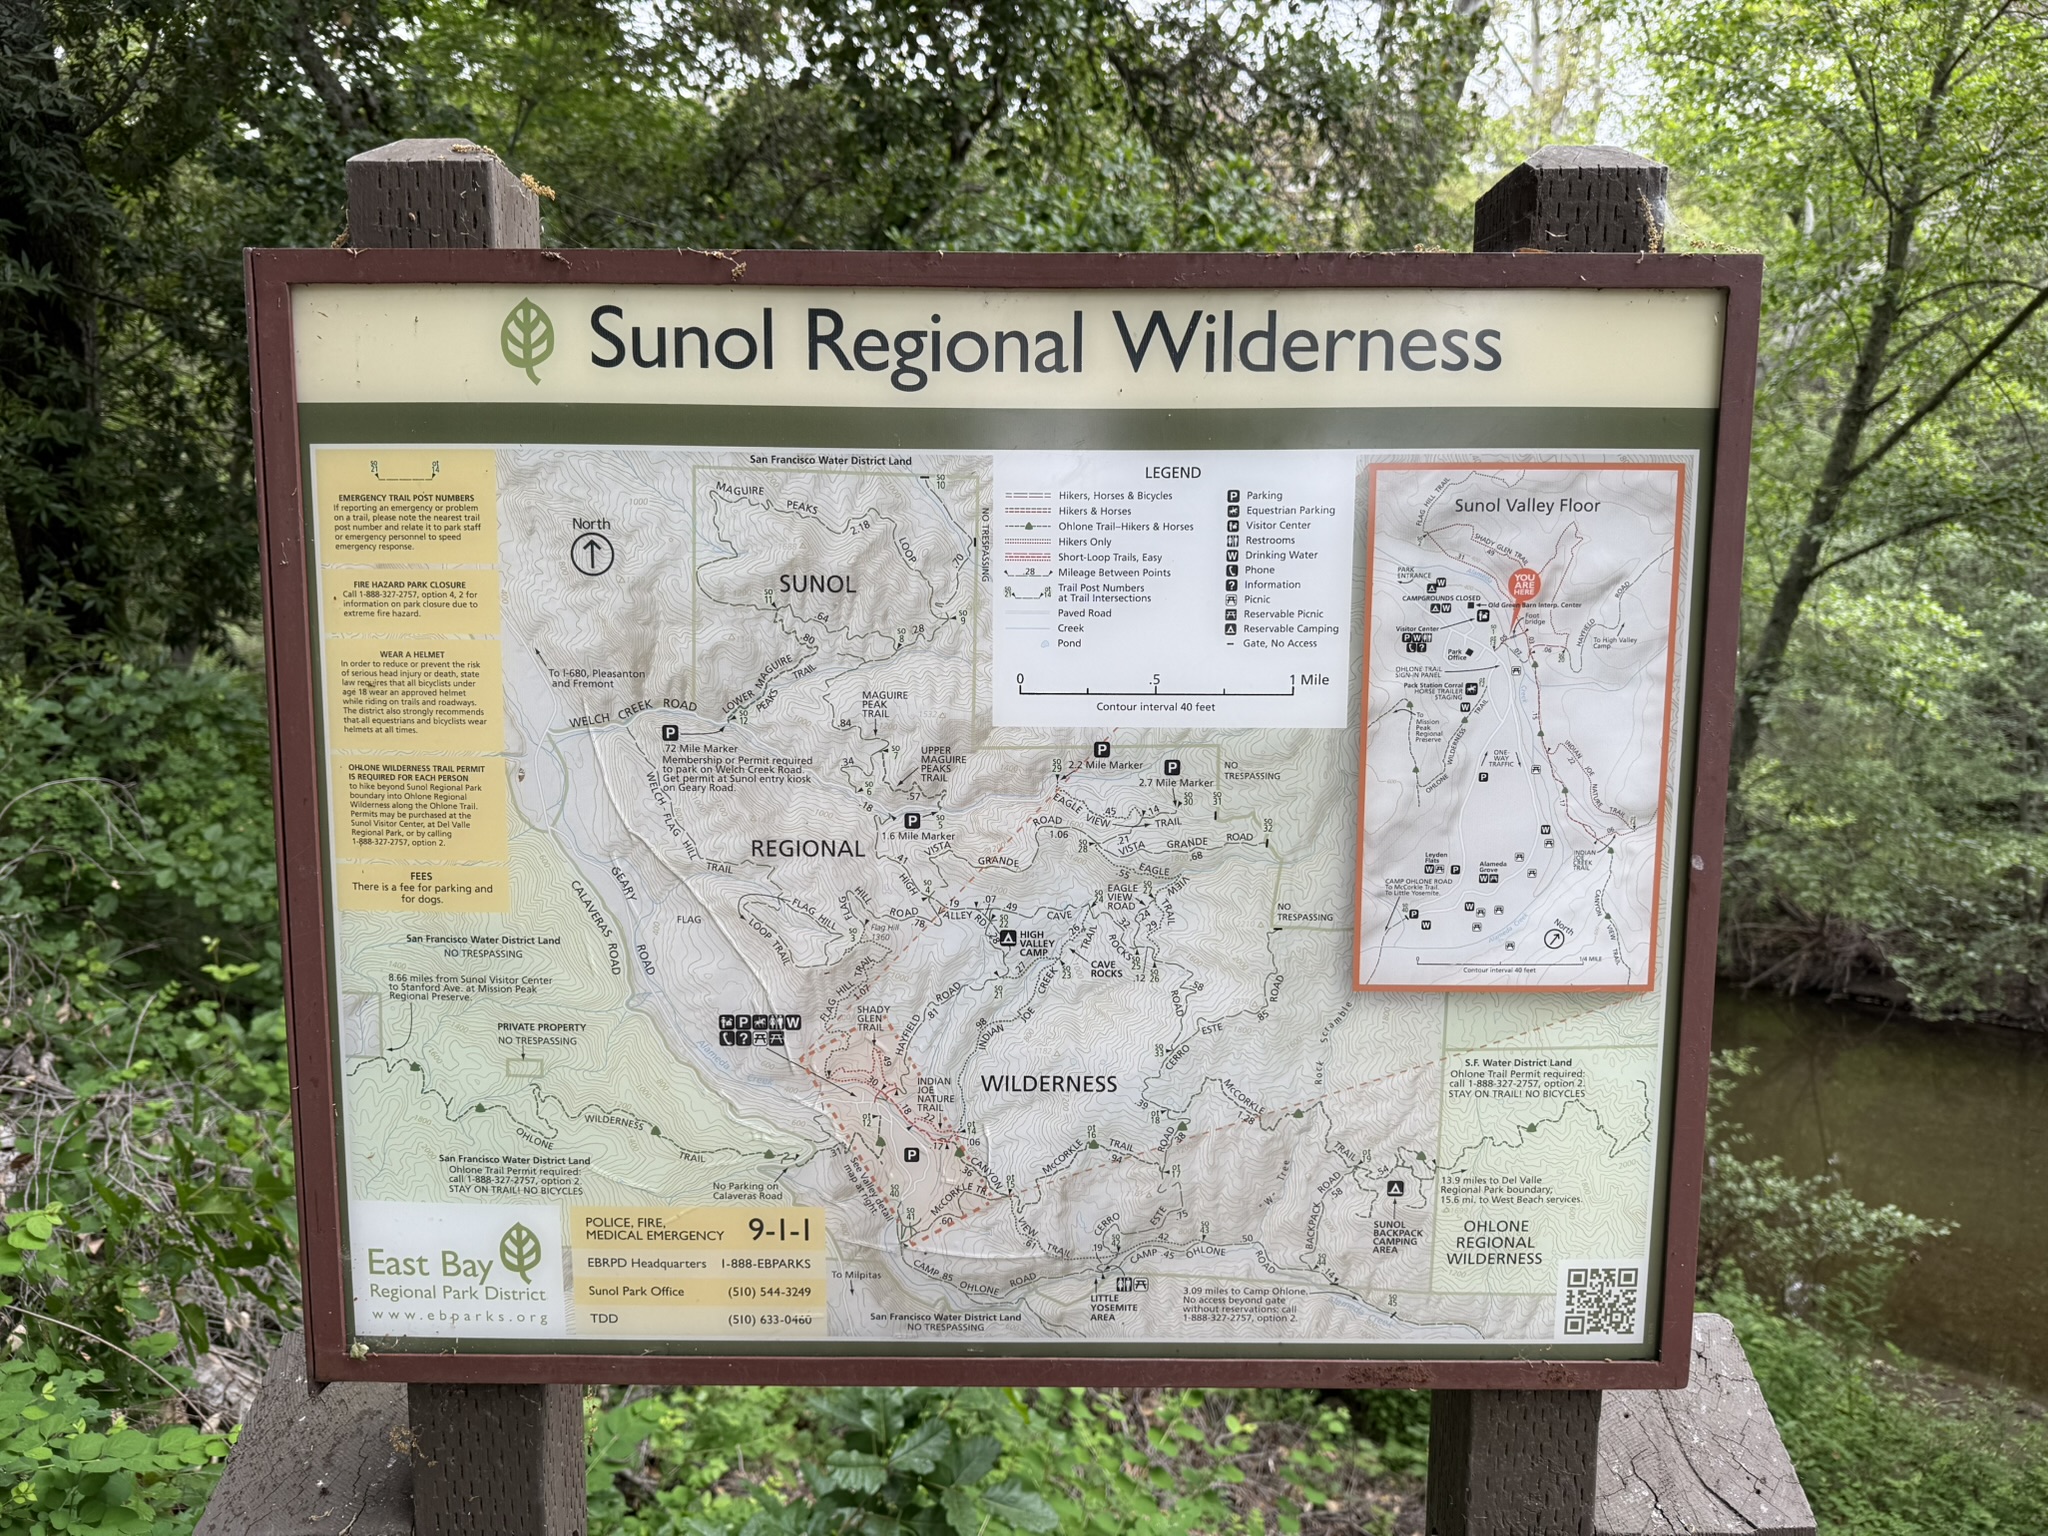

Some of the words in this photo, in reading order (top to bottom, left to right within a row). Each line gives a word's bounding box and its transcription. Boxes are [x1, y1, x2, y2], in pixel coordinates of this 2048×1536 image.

[591, 304, 773, 370] Sunol
[808, 303, 1083, 392] Regional
[1112, 309, 1502, 373] Wilderness
[750, 455, 768, 464] San
[771, 455, 816, 465] Francisco
[818, 456, 849, 465] Water
[851, 456, 886, 466] District
[889, 456, 912, 466] Land
[1146, 466, 1201, 479] LEGEND
[339, 494, 387, 502] EMERGENCY
[389, 494, 411, 502] TRAIL
[413, 494, 434, 502] POST
[435, 494, 475, 502] NUMBERS
[1059, 491, 1090, 501] Hikers,
[1094, 492, 1125, 500] Horses
[1127, 491, 1134, 500] &
[1137, 491, 1173, 502] Bicycles
[1247, 491, 1283, 502] Parking
[341, 504, 377, 514] reporting
[391, 505, 433, 514] emergency
[445, 504, 479, 513] problem
[1059, 507, 1088, 516] Hikers
[1091, 507, 1097, 516] &
[1101, 507, 1132, 516] Horses
[1247, 506, 1297, 517] Equestrian
[1299, 506, 1336, 517] Parking
[1455, 498, 1500, 513] Sunol
[1506, 498, 1555, 516] Valley
[1560, 498, 1601, 513] Floor
[573, 517, 611, 530] North
[1059, 522, 1093, 531] Ohlone
[1153, 522, 1160, 531] &
[1163, 522, 1194, 531] Horses
[1246, 521, 1277, 530] Visitor
[1279, 521, 1311, 530] Center
[1059, 537, 1088, 547] Hikers
[1090, 537, 1112, 549] Only
[1246, 536, 1296, 545] Restrooms
[1058, 552, 1111, 564] Short-Loop
[1113, 553, 1139, 563] Trails,
[1142, 553, 1163, 564] Easy
[1246, 550, 1286, 562] Drinking
[1289, 551, 1318, 559] Water
[1058, 568, 1096, 579] Mileage
[1099, 568, 1140, 577] Between
[1143, 568, 1171, 577] Points
[1245, 565, 1275, 574] Phone
[1515, 574, 1536, 582] YOU
[354, 581, 369, 589] FIRE
[371, 581, 405, 589] HAZARD
[407, 581, 428, 589] PARK
[430, 581, 466, 589] CLOSURE
[780, 574, 857, 594] SUNOL
[1058, 583, 1078, 592] Trail
[1080, 583, 1100, 592] Post
[1103, 583, 1145, 593] Numbers
[1245, 580, 1301, 589] Information
[1515, 581, 1535, 589] ARE
[1058, 594, 1068, 602] at
[1070, 593, 1090, 602] Trail
[1092, 594, 1152, 602] Intersections
[1244, 595, 1270, 604] Picnic
[377, 609, 391, 617] fire
[392, 610, 421, 618] hazard.
[1058, 609, 1086, 617] Paved
[1088, 609, 1112, 617] Road
[1244, 609, 1295, 618] Reservable
[1297, 609, 1324, 618] Picnic
[1058, 624, 1084, 633] Creek
[1244, 624, 1295, 633] Reservable
[1297, 624, 1339, 635] Camping
[1058, 639, 1081, 647] Pond
[1243, 639, 1268, 649] Gate,
[1271, 639, 1285, 648] No
[1287, 639, 1317, 648] Access
[1017, 673, 1025, 684] 0
[1149, 674, 1160, 685] .5
[1290, 674, 1295, 685] 1
[1301, 674, 1330, 686] Mile
[862, 691, 908, 700] MAGUIRE
[862, 700, 888, 709] PEAK
[1096, 702, 1137, 711] Contour
[1140, 702, 1178, 711] interval
[1180, 702, 1193, 712] 40
[1195, 702, 1215, 712] feet
[862, 710, 890, 718] TRAIL
[882, 832, 896, 840] 1.6
[898, 832, 919, 840] Mile
[921, 832, 956, 842] Marker
[752, 840, 866, 857] REGIONAL
[411, 872, 433, 881] FEES
[352, 882, 379, 891] There
[382, 883, 389, 891] is
[391, 884, 397, 892] a
[400, 883, 415, 892] fee
[417, 883, 432, 893] for
[435, 884, 472, 895] parking
[474, 884, 493, 893] and
[401, 895, 416, 903] for
[418, 895, 444, 906] dogs.
[1020, 931, 1044, 939] HIGH
[1020, 940, 1055, 948] VALLEY
[1020, 948, 1048, 959] CAMP
[1091, 961, 1116, 970] CAVE
[1091, 970, 1123, 978] ROCKS
[497, 1022, 535, 1031] PRIVATE
[538, 1023, 587, 1032] PROPERTY
[498, 1036, 513, 1045] NO
[515, 1036, 577, 1046] TRESPASSING
[981, 1075, 1117, 1093] WILDERNESS
[586, 1217, 634, 1229] POLICE,
[638, 1218, 666, 1229] FIRE,
[1374, 1221, 1406, 1229] SUNOL
[1464, 1220, 1529, 1233] OHLONE
[749, 1218, 809, 1241] 9-1-1
[1373, 1229, 1423, 1237] BACKPACK
[586, 1230, 643, 1241] MEDICAL
[647, 1231, 725, 1241] EMERGENCY
[1373, 1238, 1418, 1247] CAMPING
[1457, 1237, 1535, 1249] REGIONAL
[1372, 1246, 1398, 1254] AREA
[588, 1257, 628, 1268] EBRPD
[631, 1258, 707, 1271] Headquarters
[722, 1258, 811, 1269] 1-888-EBPARKS
[1446, 1253, 1542, 1265] WILDERNESS
[368, 1248, 430, 1277] East
[441, 1250, 494, 1286] Bay
[832, 1271, 843, 1279] To
[845, 1271, 882, 1281] Milpitas
[370, 1283, 436, 1302] Regional
[442, 1285, 480, 1300] Park
[484, 1285, 547, 1302] District
[589, 1286, 619, 1296] Sunol
[623, 1286, 647, 1296] Park
[650, 1286, 685, 1297] Office
[728, 1287, 756, 1299] (510)
[760, 1287, 811, 1297] 544-3249
[372, 1310, 548, 1327] www.ebparks.org
[590, 1313, 619, 1324] TDD
[728, 1314, 756, 1327] (510)
